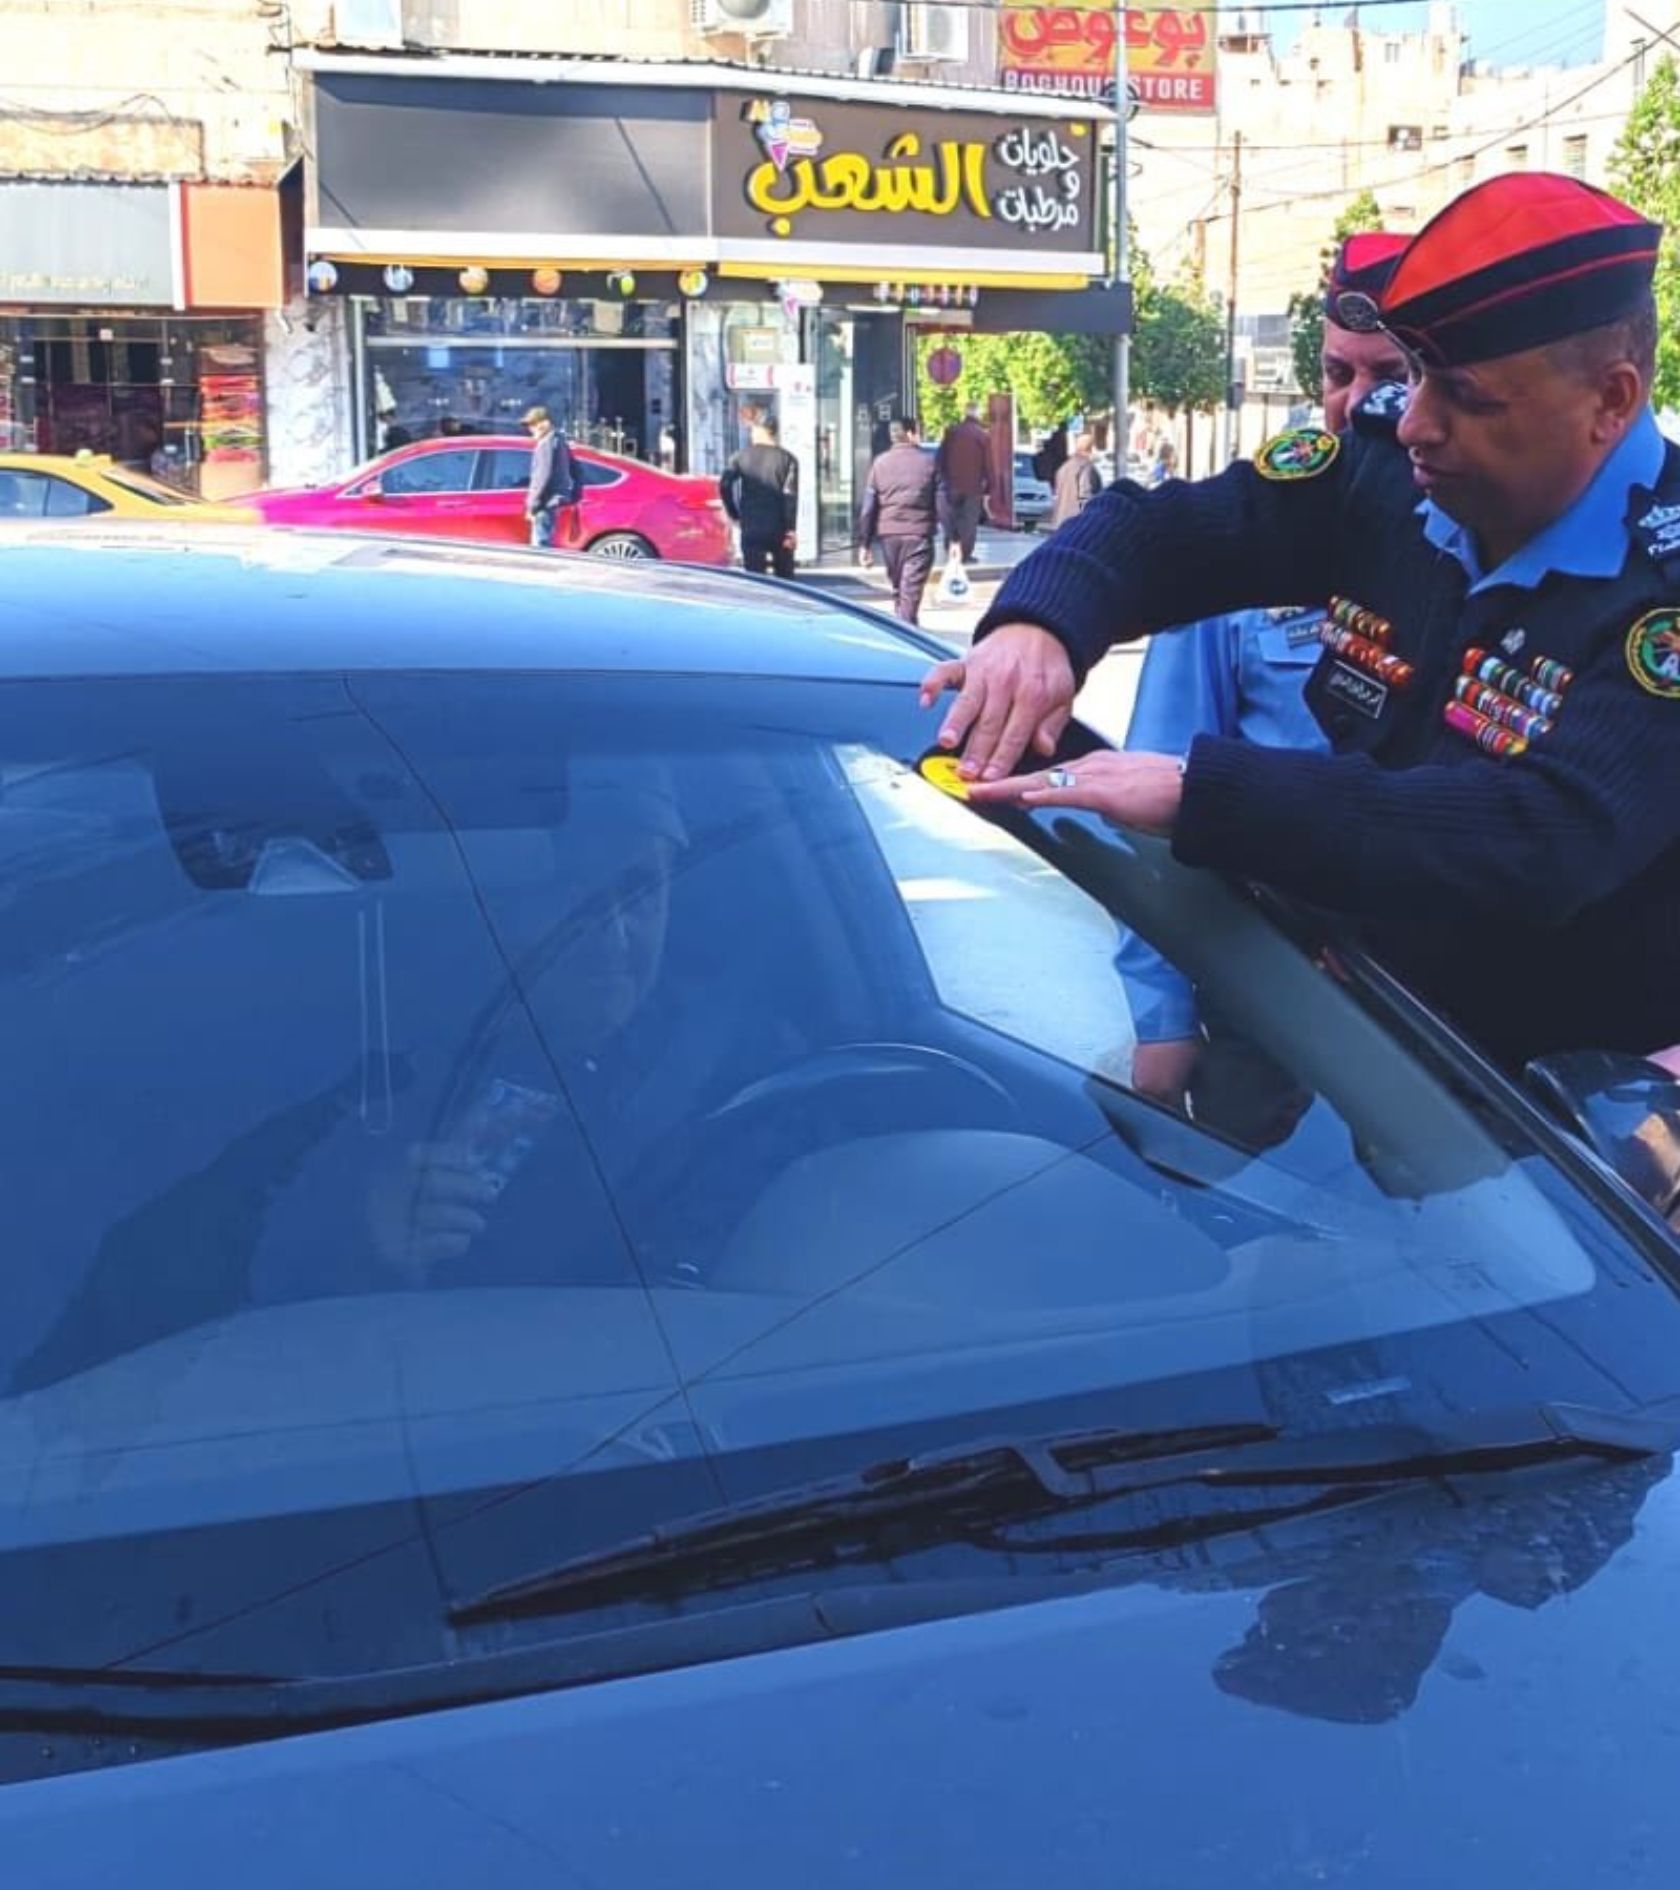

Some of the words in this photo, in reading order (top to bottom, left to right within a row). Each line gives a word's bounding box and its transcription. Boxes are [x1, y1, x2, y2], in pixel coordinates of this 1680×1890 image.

[1000, 127, 1080, 175] حلويات
[748, 130, 991, 237] الشعب
[1064, 170, 1080, 199] و
[1000, 185, 1079, 232] مرطبات
